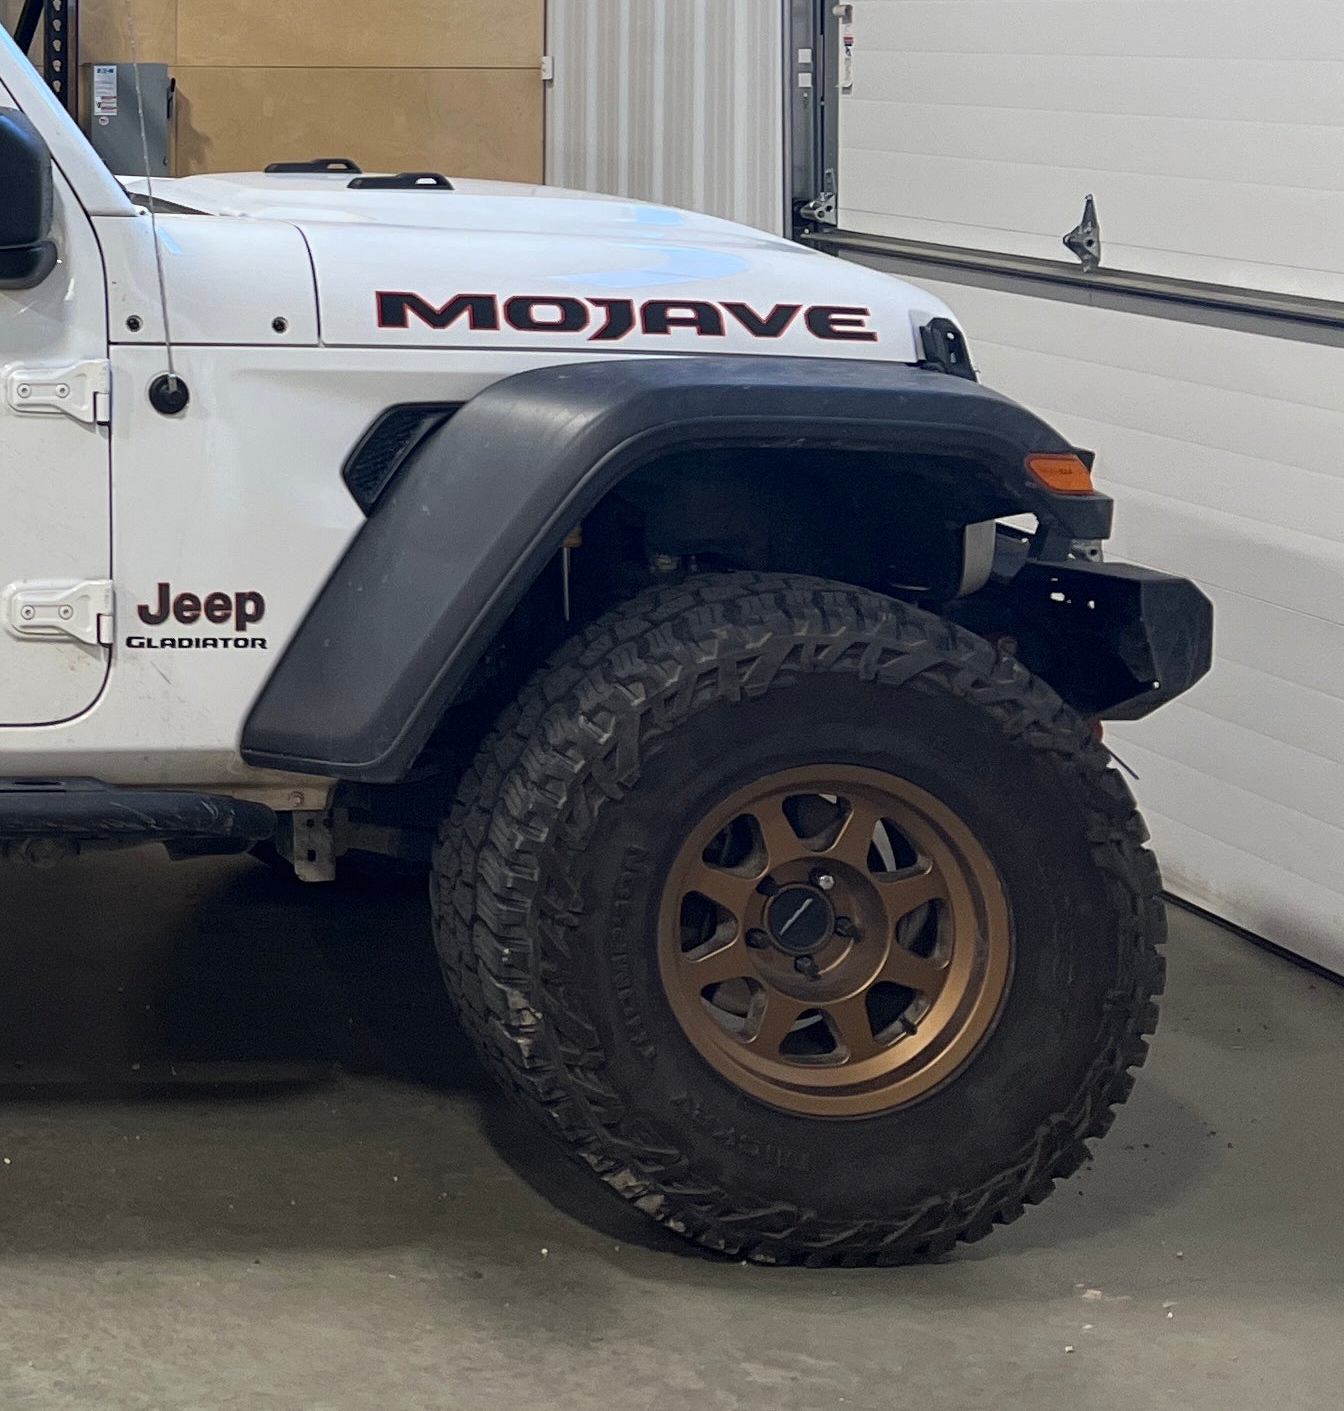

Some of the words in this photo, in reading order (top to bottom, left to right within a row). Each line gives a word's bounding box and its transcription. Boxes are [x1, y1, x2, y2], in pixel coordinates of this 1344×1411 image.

[374, 290, 878, 342] MOJAVE
[137, 582, 266, 632] Jeep
[125, 636, 268, 650] GLADIATOR
